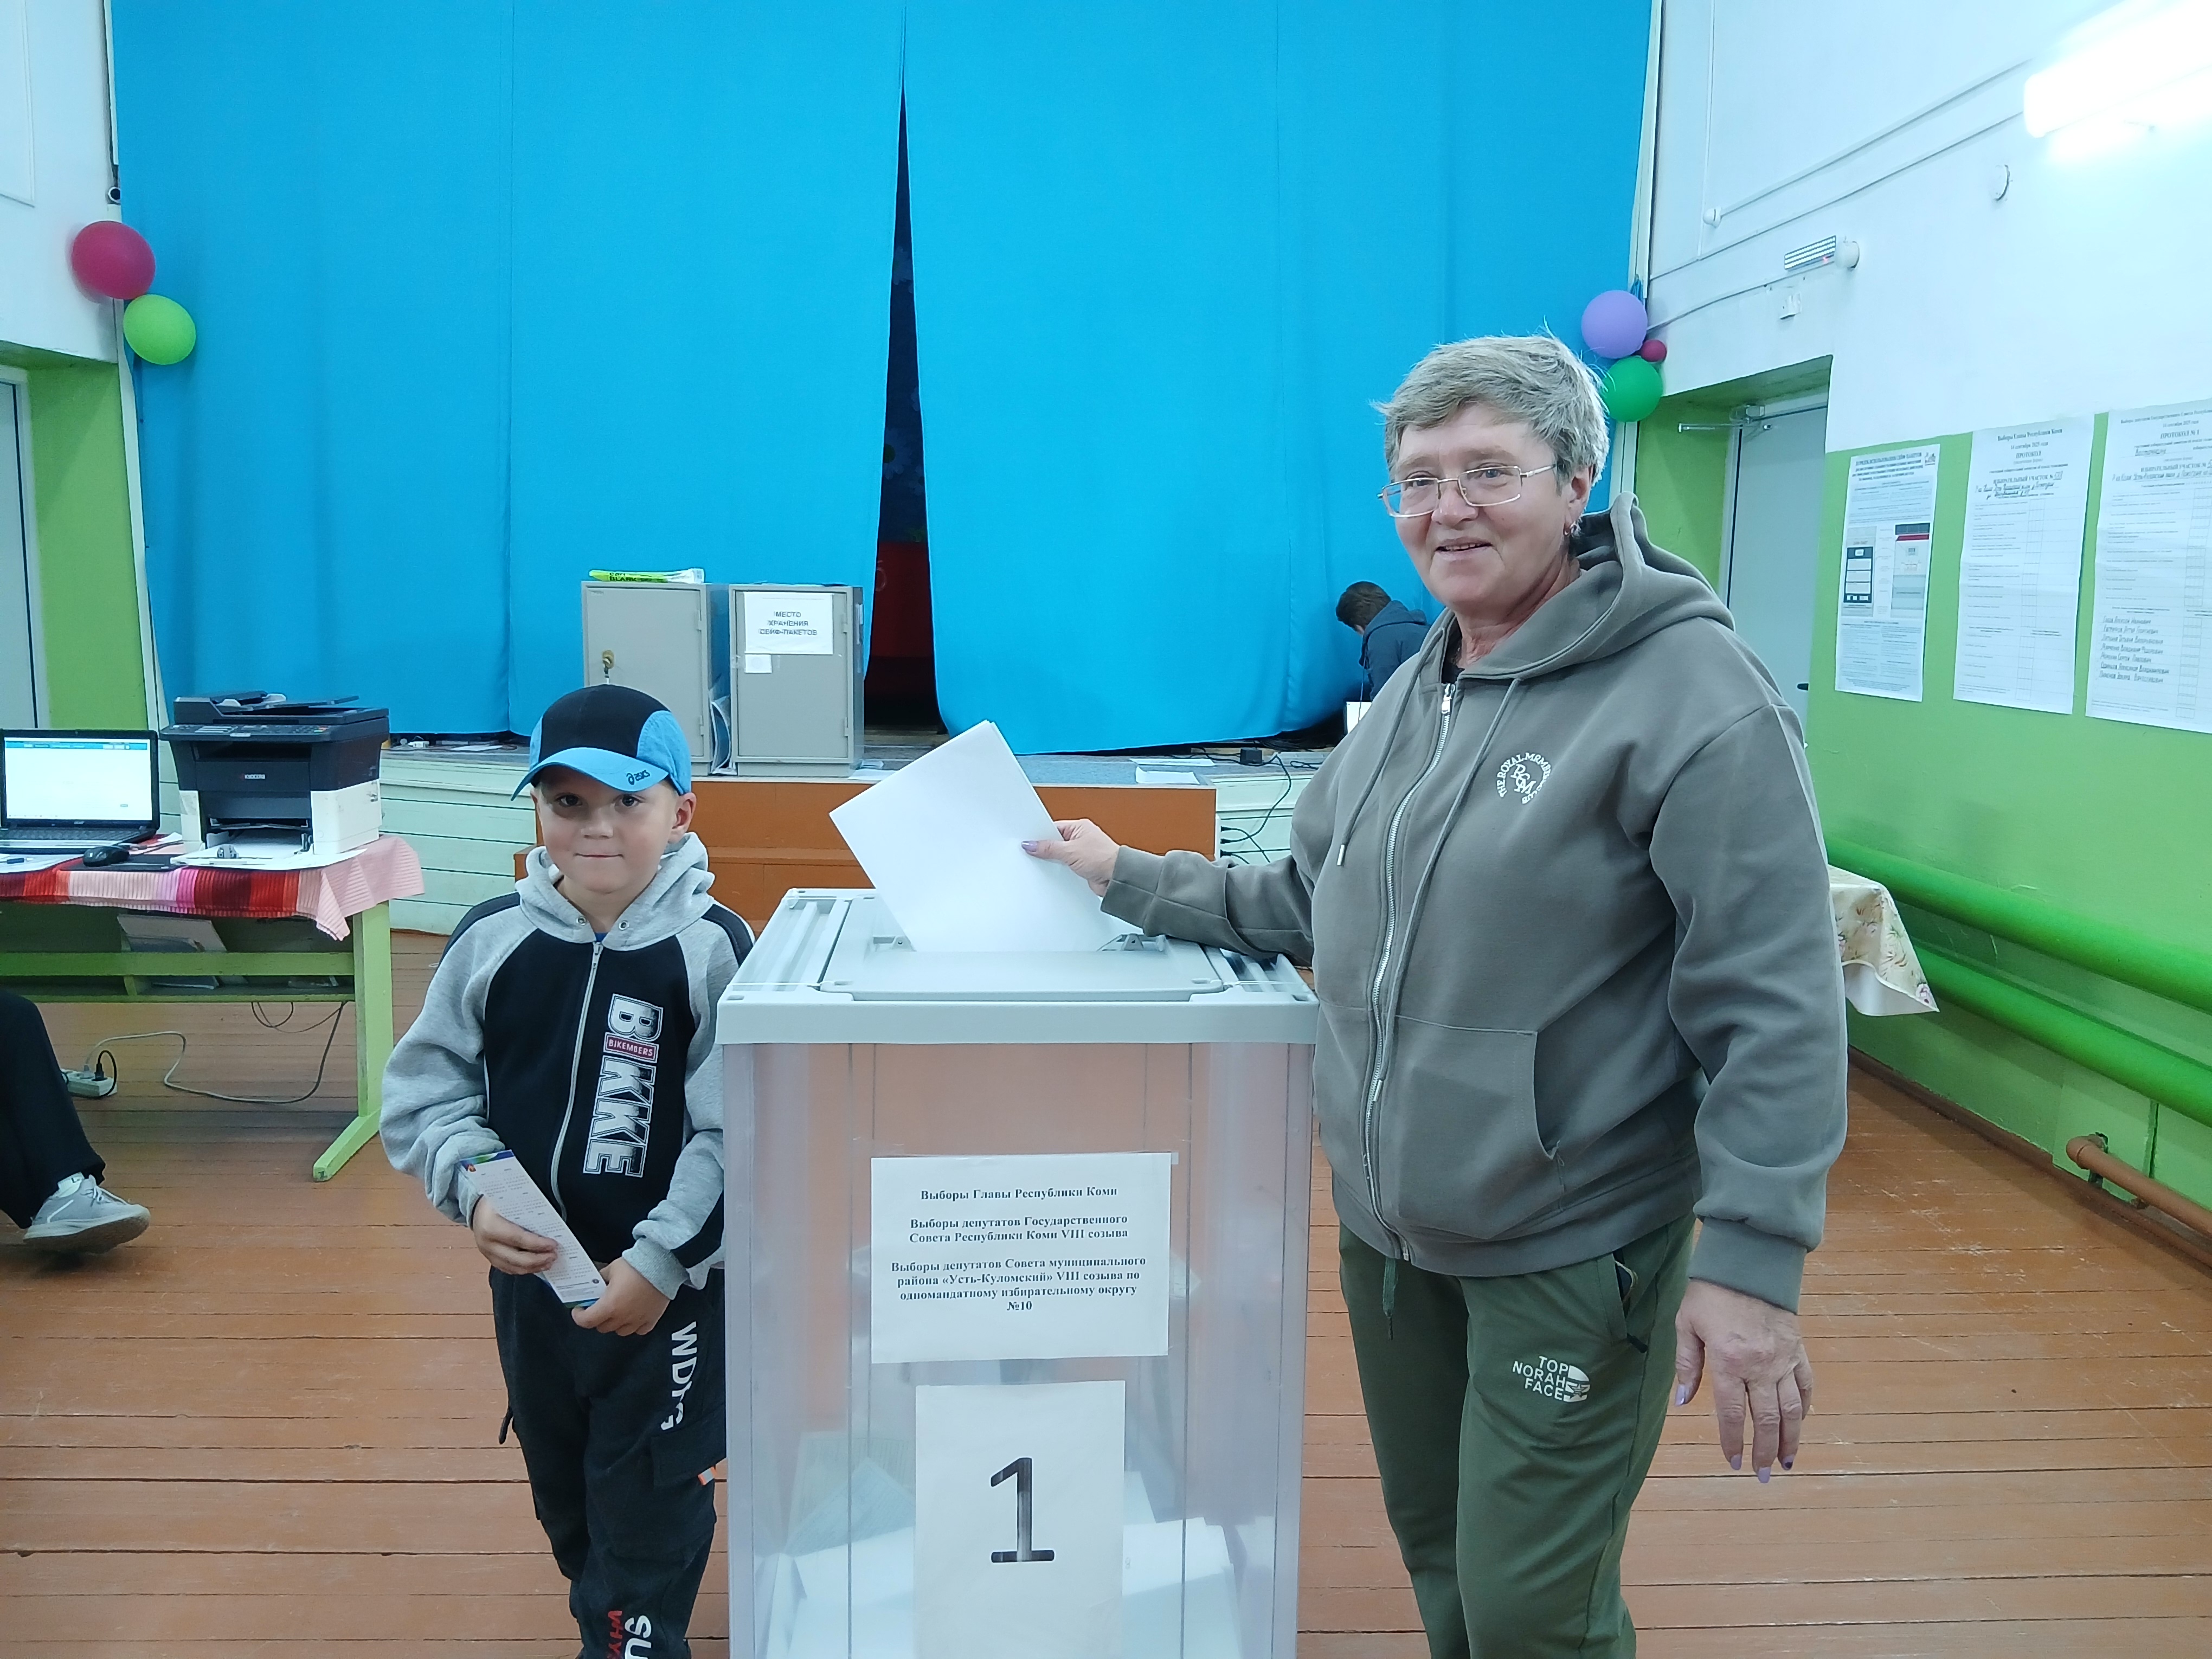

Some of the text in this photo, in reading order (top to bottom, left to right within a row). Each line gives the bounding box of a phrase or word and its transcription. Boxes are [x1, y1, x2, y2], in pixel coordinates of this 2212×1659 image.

[921, 1186, 1117, 1202] Выборы Главы Республики Коми
[910, 1216, 1128, 1231] Выборы депутатов Государственного
[909, 1229, 1128, 1244] Совета Республики Коми VIII созыва
[891, 1256, 1146, 1274] Выборы депутатов Совета муниципального
[897, 1276, 938, 1289] района
[942, 1272, 1053, 1285] «Усть-Куломский»
[1056, 1271, 1079, 1281] VIII
[1083, 1272, 1123, 1280] созыва
[900, 1287, 1137, 1301] одномандатному избирательному округу
[1006, 1301, 1033, 1311] №10
[1512, 1360, 1566, 1388] NORAH
[1539, 1355, 1568, 1375] TOP
[1525, 1378, 1564, 1400] FACE
[991, 1457, 1055, 1563] 1
